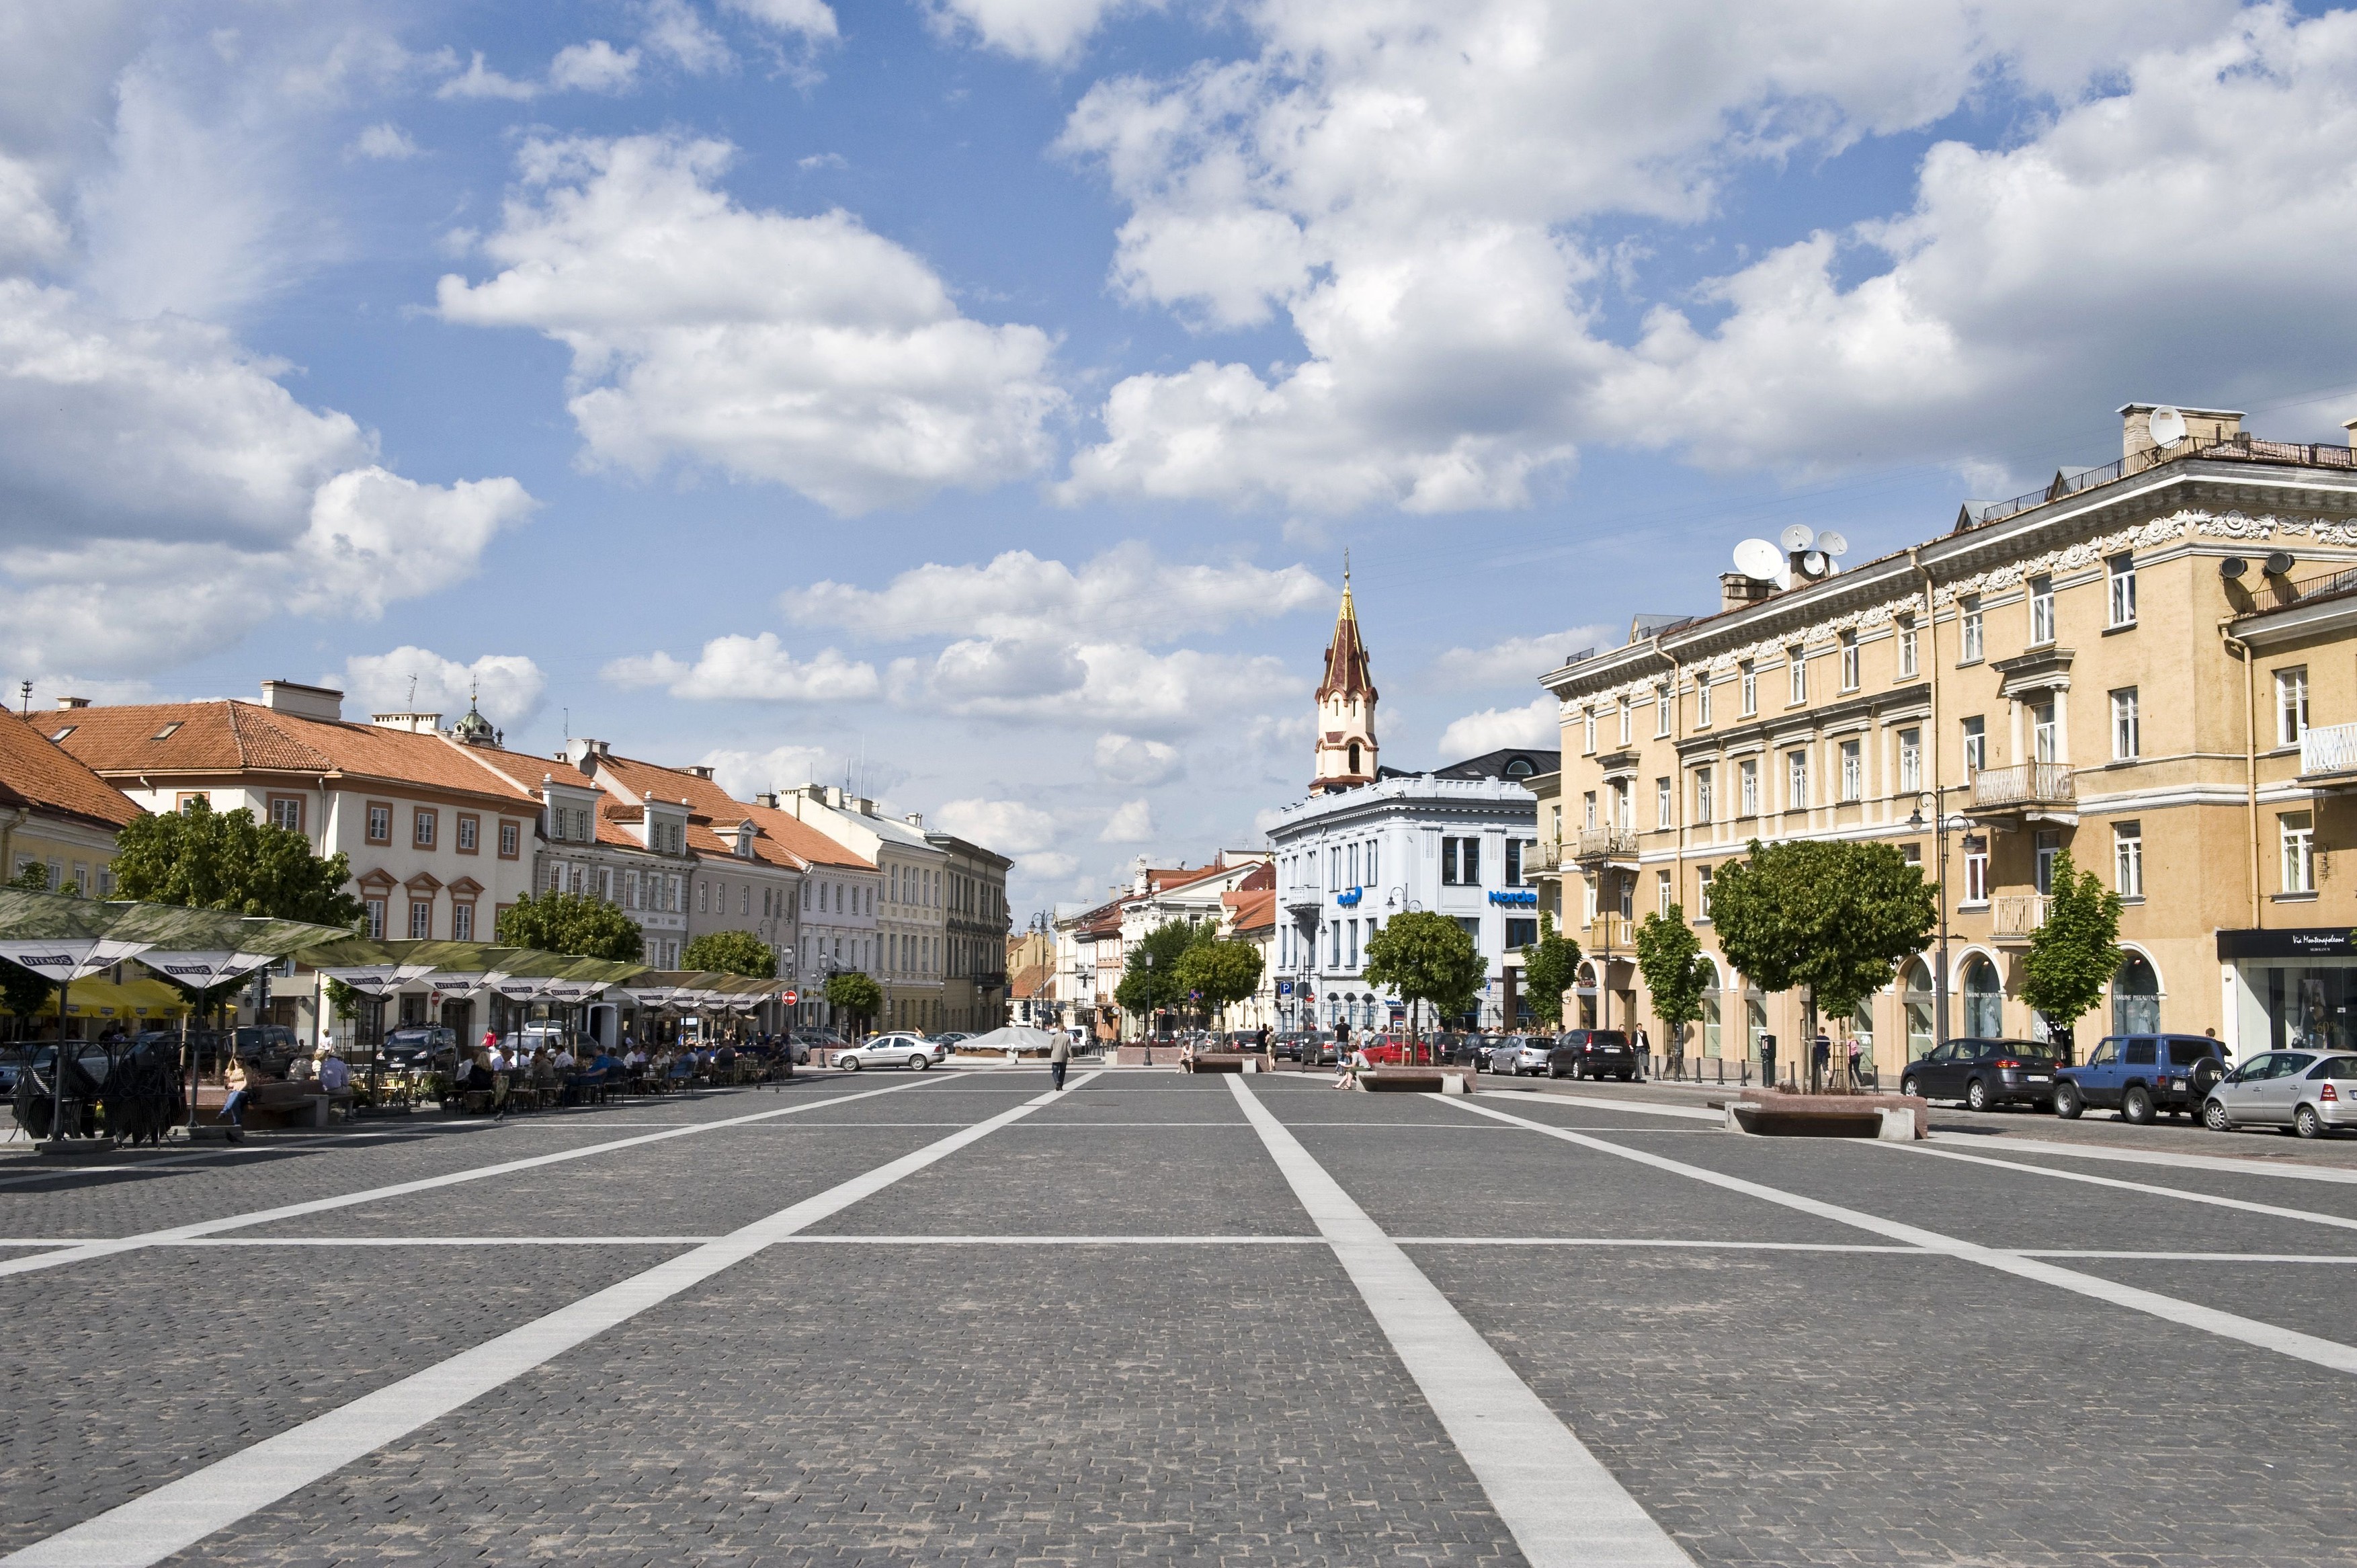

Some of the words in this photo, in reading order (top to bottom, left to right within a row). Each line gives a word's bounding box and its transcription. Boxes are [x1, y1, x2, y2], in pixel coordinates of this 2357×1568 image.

[2292, 935, 2302, 944] Via
[2303, 934, 2344, 946] Montenapoleone
[22, 956, 71, 965] UTENOS
[1283, 983, 1290, 993] P
[2033, 1022, 2053, 1035] -30%
[2313, 1021, 2340, 1033] -60%
[2210, 1072, 2222, 1081] V6
